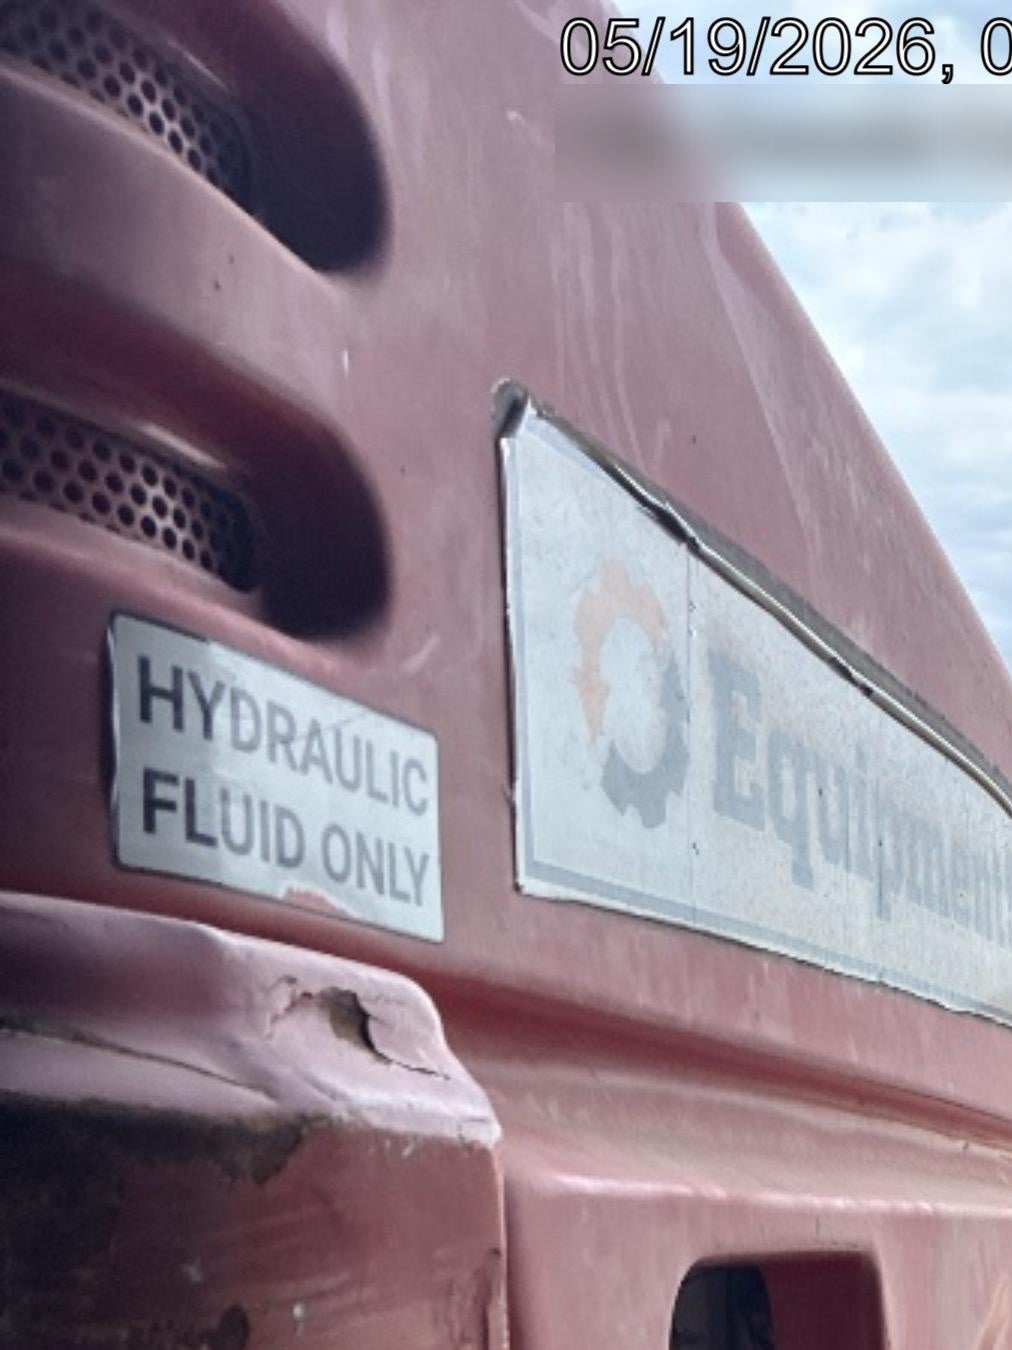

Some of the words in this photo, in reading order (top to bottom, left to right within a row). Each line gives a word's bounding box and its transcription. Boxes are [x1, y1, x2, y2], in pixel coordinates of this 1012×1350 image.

[137, 655, 428, 817] HYDRAULIC
[142, 767, 305, 868] FLUID
[321, 822, 429, 906] ONLY
